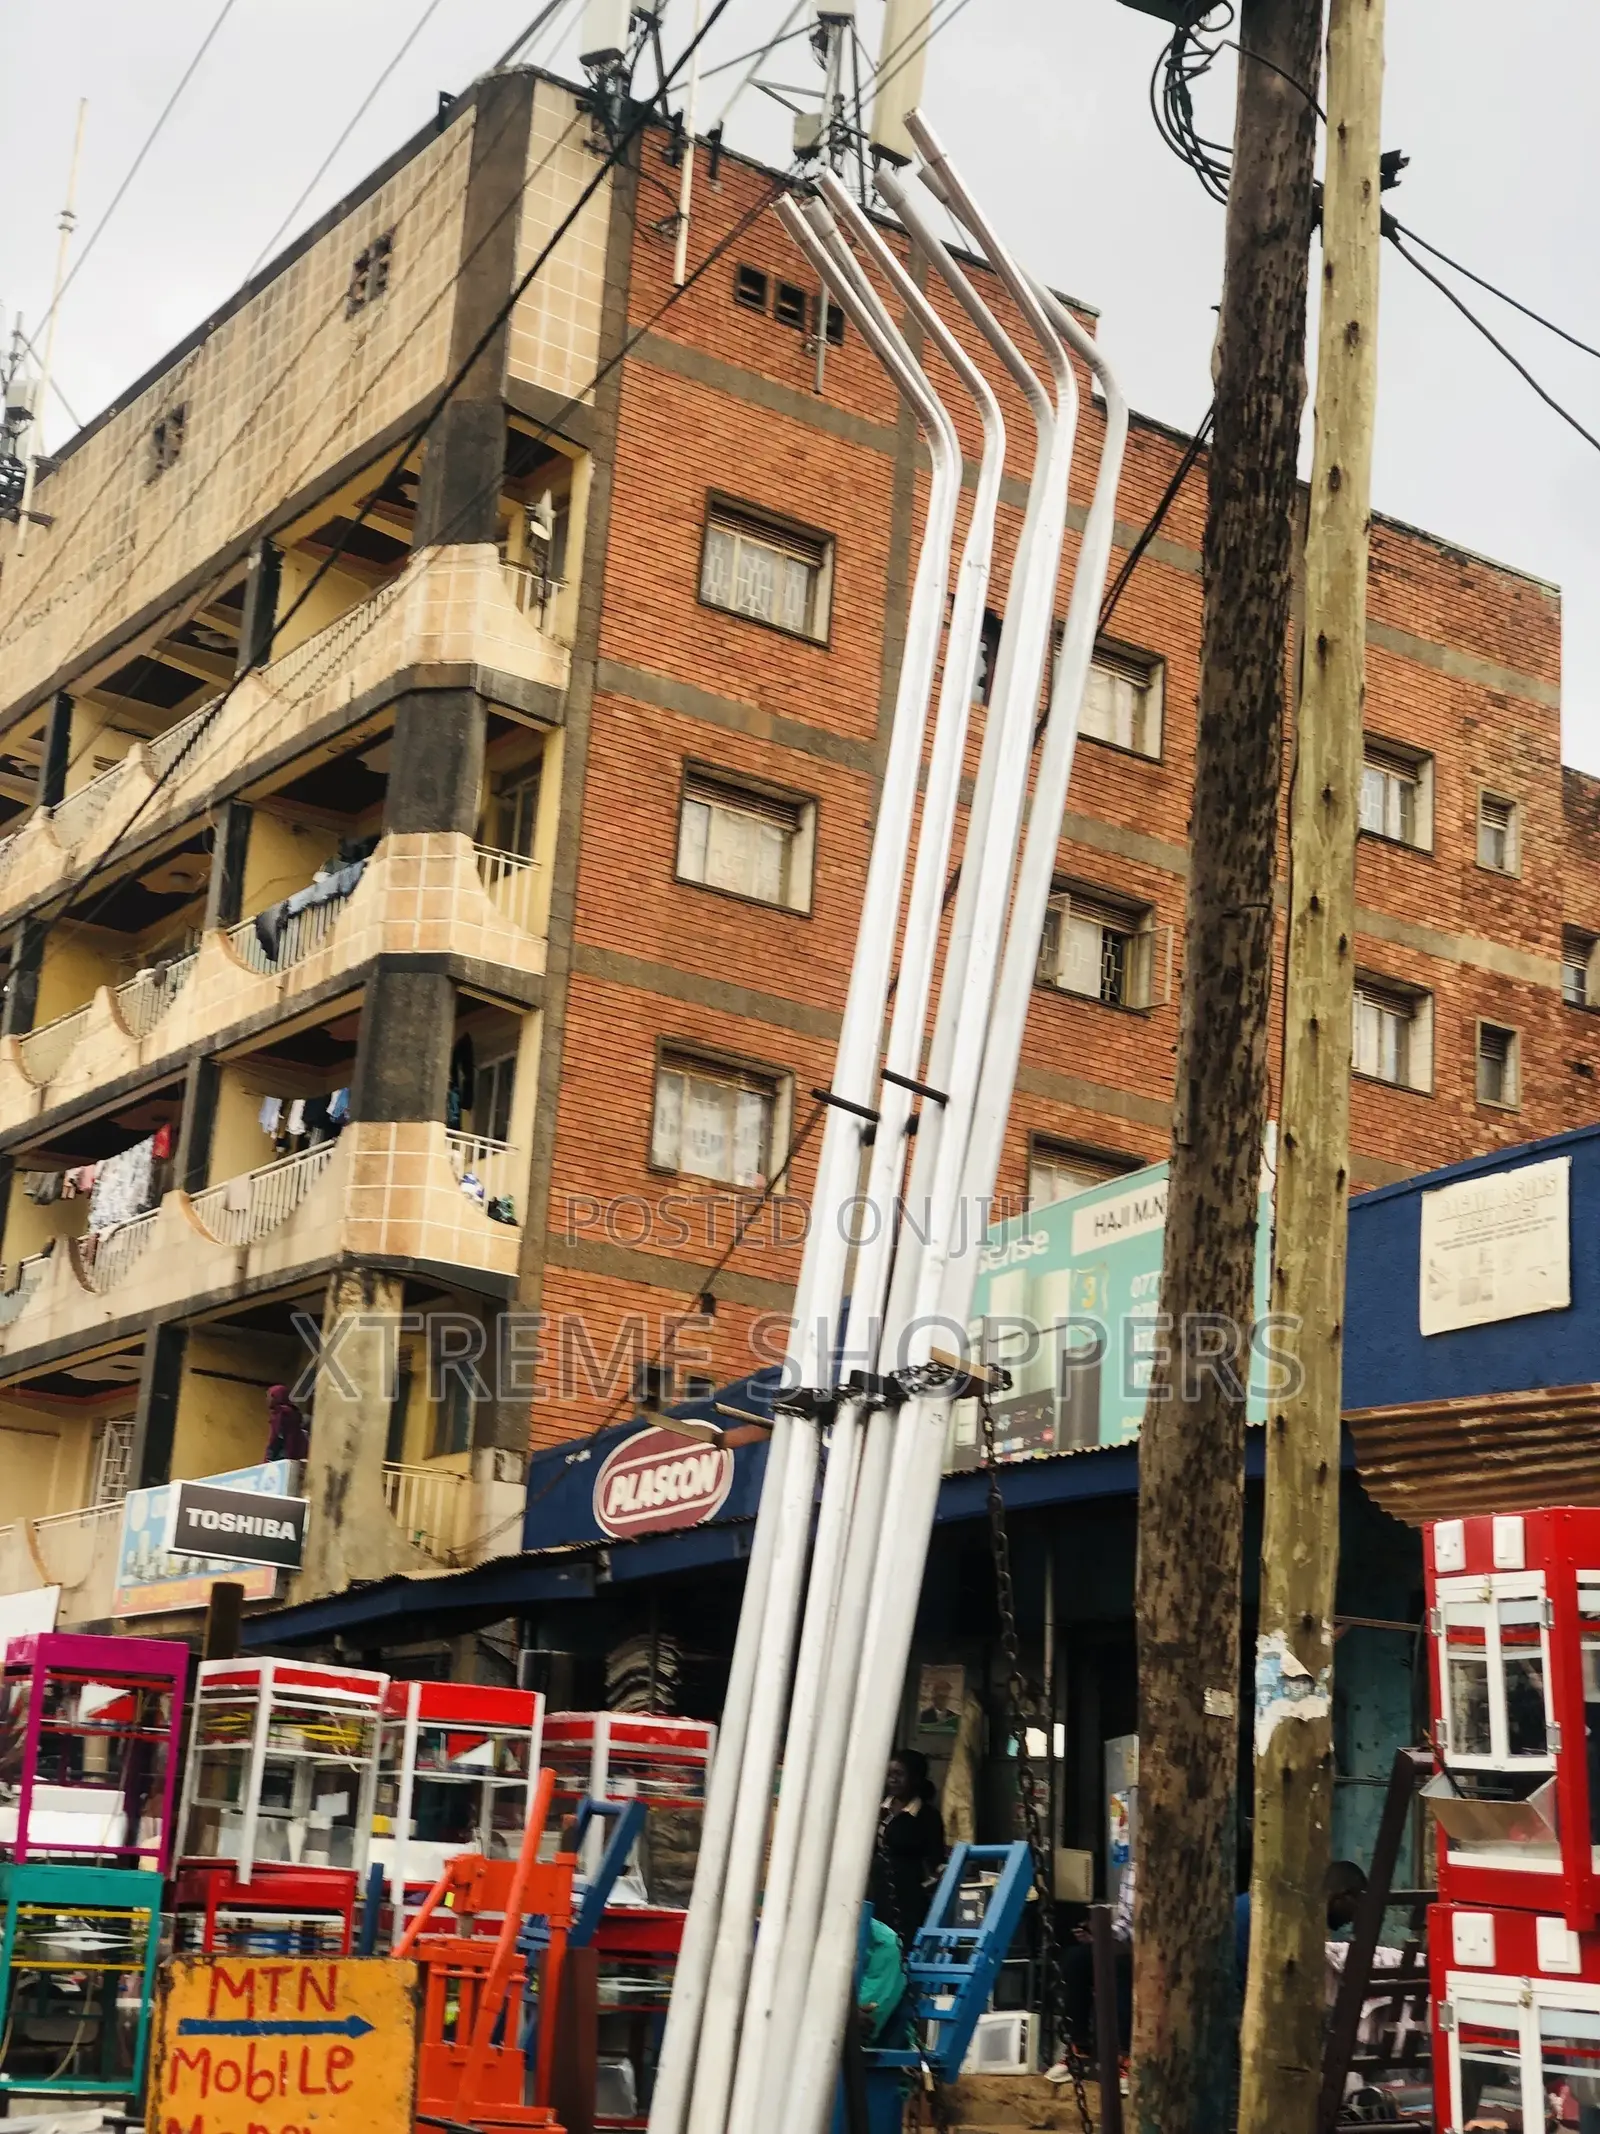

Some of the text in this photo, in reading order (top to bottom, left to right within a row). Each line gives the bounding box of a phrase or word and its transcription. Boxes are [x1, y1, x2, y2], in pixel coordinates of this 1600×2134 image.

[1133, 1192, 1167, 1224] M.N
[605, 1451, 722, 1516] PLASCON
[185, 1507, 297, 1541] TOSHIBA
[207, 1964, 338, 2019] MTN
